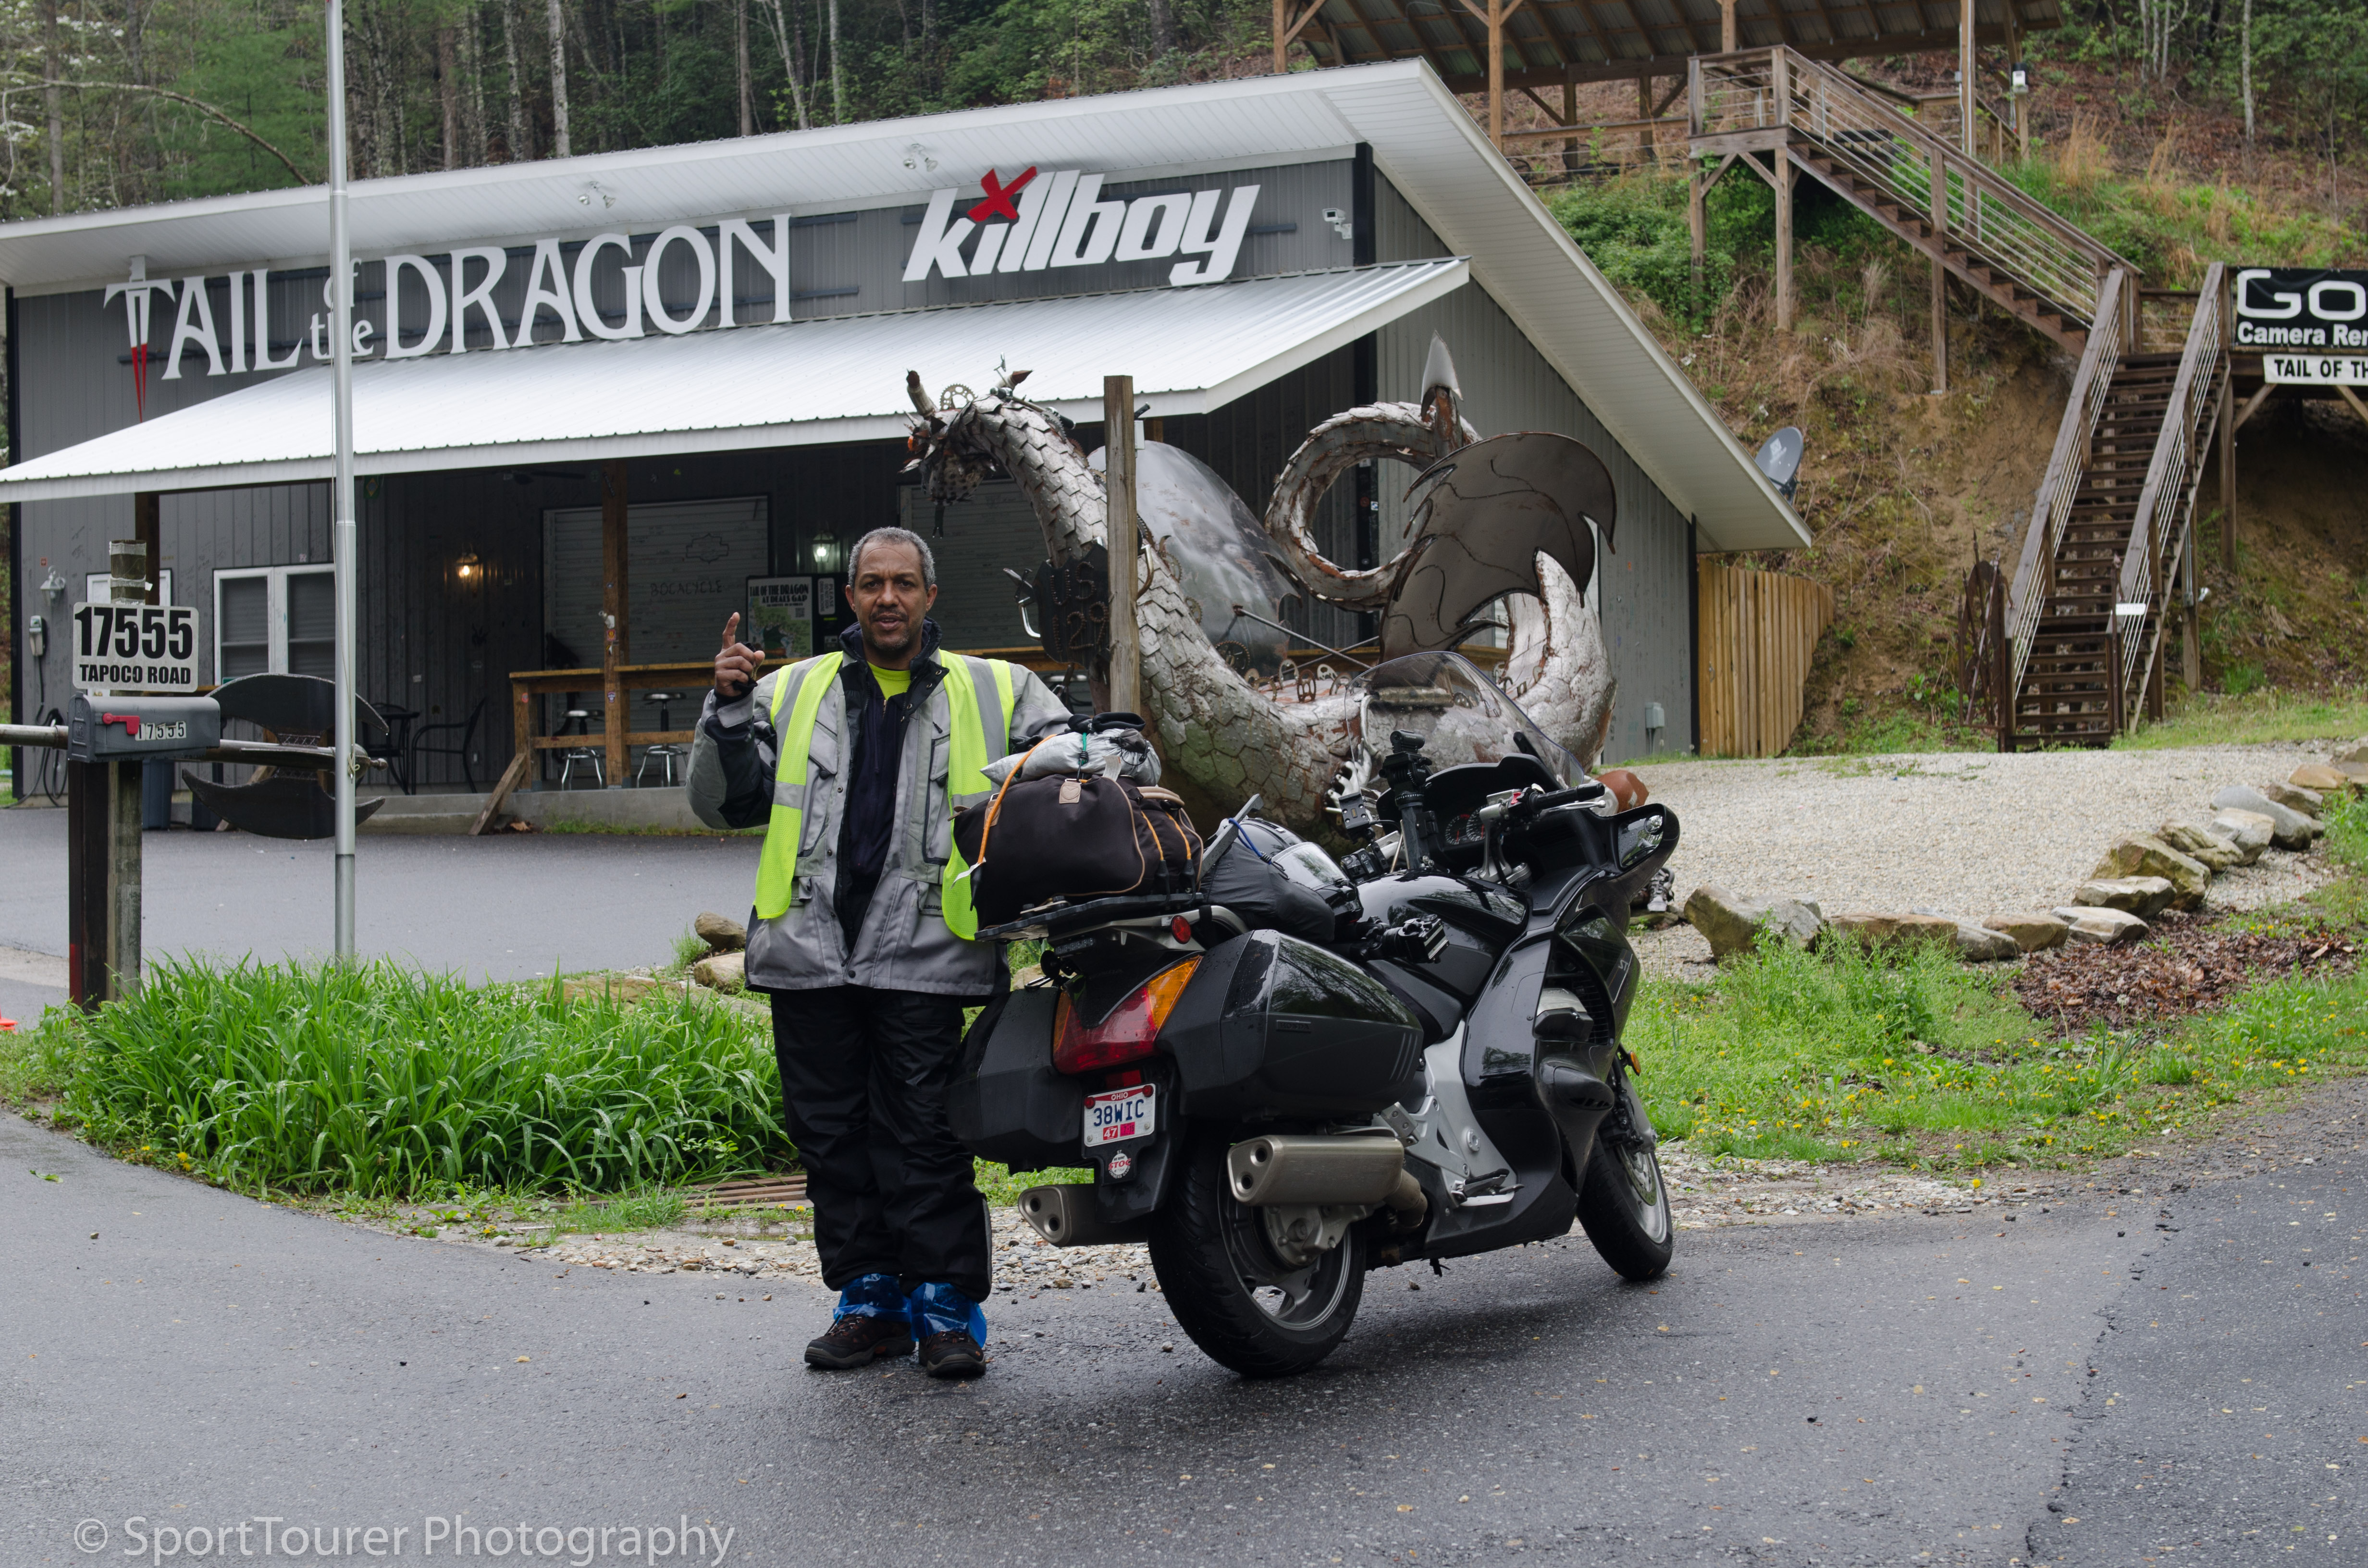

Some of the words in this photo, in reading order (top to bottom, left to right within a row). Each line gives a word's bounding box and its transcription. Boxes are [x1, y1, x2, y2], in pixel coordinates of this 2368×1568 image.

[902, 167, 1261, 286] killboy
[2237, 269, 2367, 321] GO
[103, 256, 303, 422] TAIL
[384, 214, 792, 359] DRAGON
[2238, 321, 2326, 345] Camera
[2274, 359, 2311, 377] TAIL
[2320, 360, 2343, 378] OF
[750, 586, 759, 597] TAIL
[760, 586, 767, 596] OF
[768, 585, 778, 595] THE
[780, 583, 809, 595] DRAGON
[1050, 561, 1097, 605] US
[74, 606, 193, 660] 17555
[1052, 601, 1110, 653] 129
[79, 664, 143, 683] TAPOCO
[147, 666, 191, 685] ROAD
[138, 722, 185, 740] 17555
[1111, 1091, 1129, 1101] OHIO
[1093, 1099, 1144, 1127] 38WIC
[1104, 1127, 1118, 1138] 47
[1108, 1158, 1132, 1170] STOC
